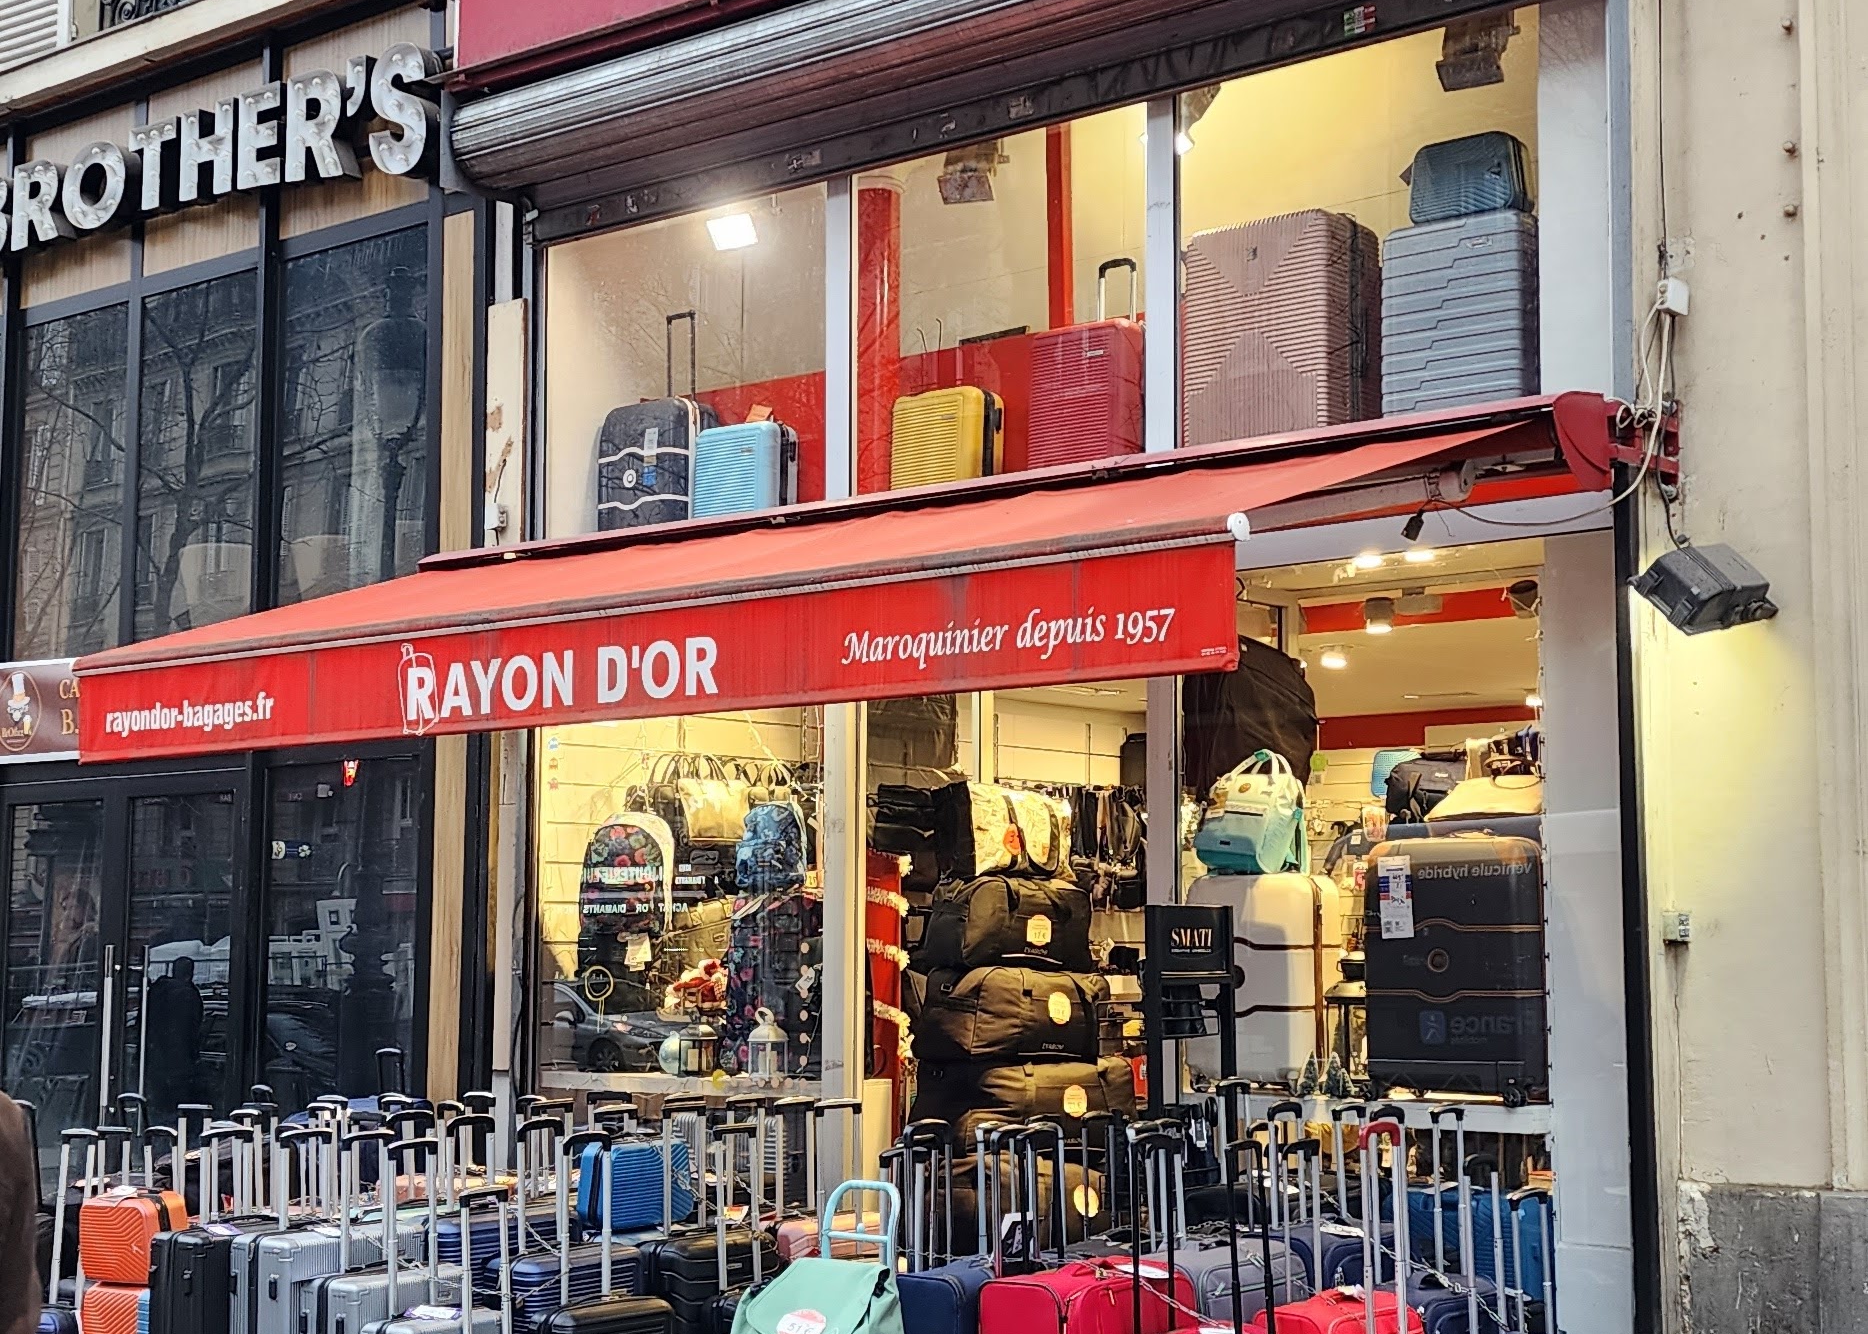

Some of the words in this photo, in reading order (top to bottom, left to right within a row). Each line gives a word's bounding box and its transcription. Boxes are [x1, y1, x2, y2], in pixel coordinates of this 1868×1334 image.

[0, 41, 428, 253] ROTHER'S
[841, 620, 1009, 670] Maroquinier
[1016, 607, 1106, 660] depuis
[1114, 608, 1176, 645] 1957
[105, 690, 275, 738] rayondor-bagages.fr
[407, 649, 574, 721] RAYON
[597, 636, 718, 703] D'OR
